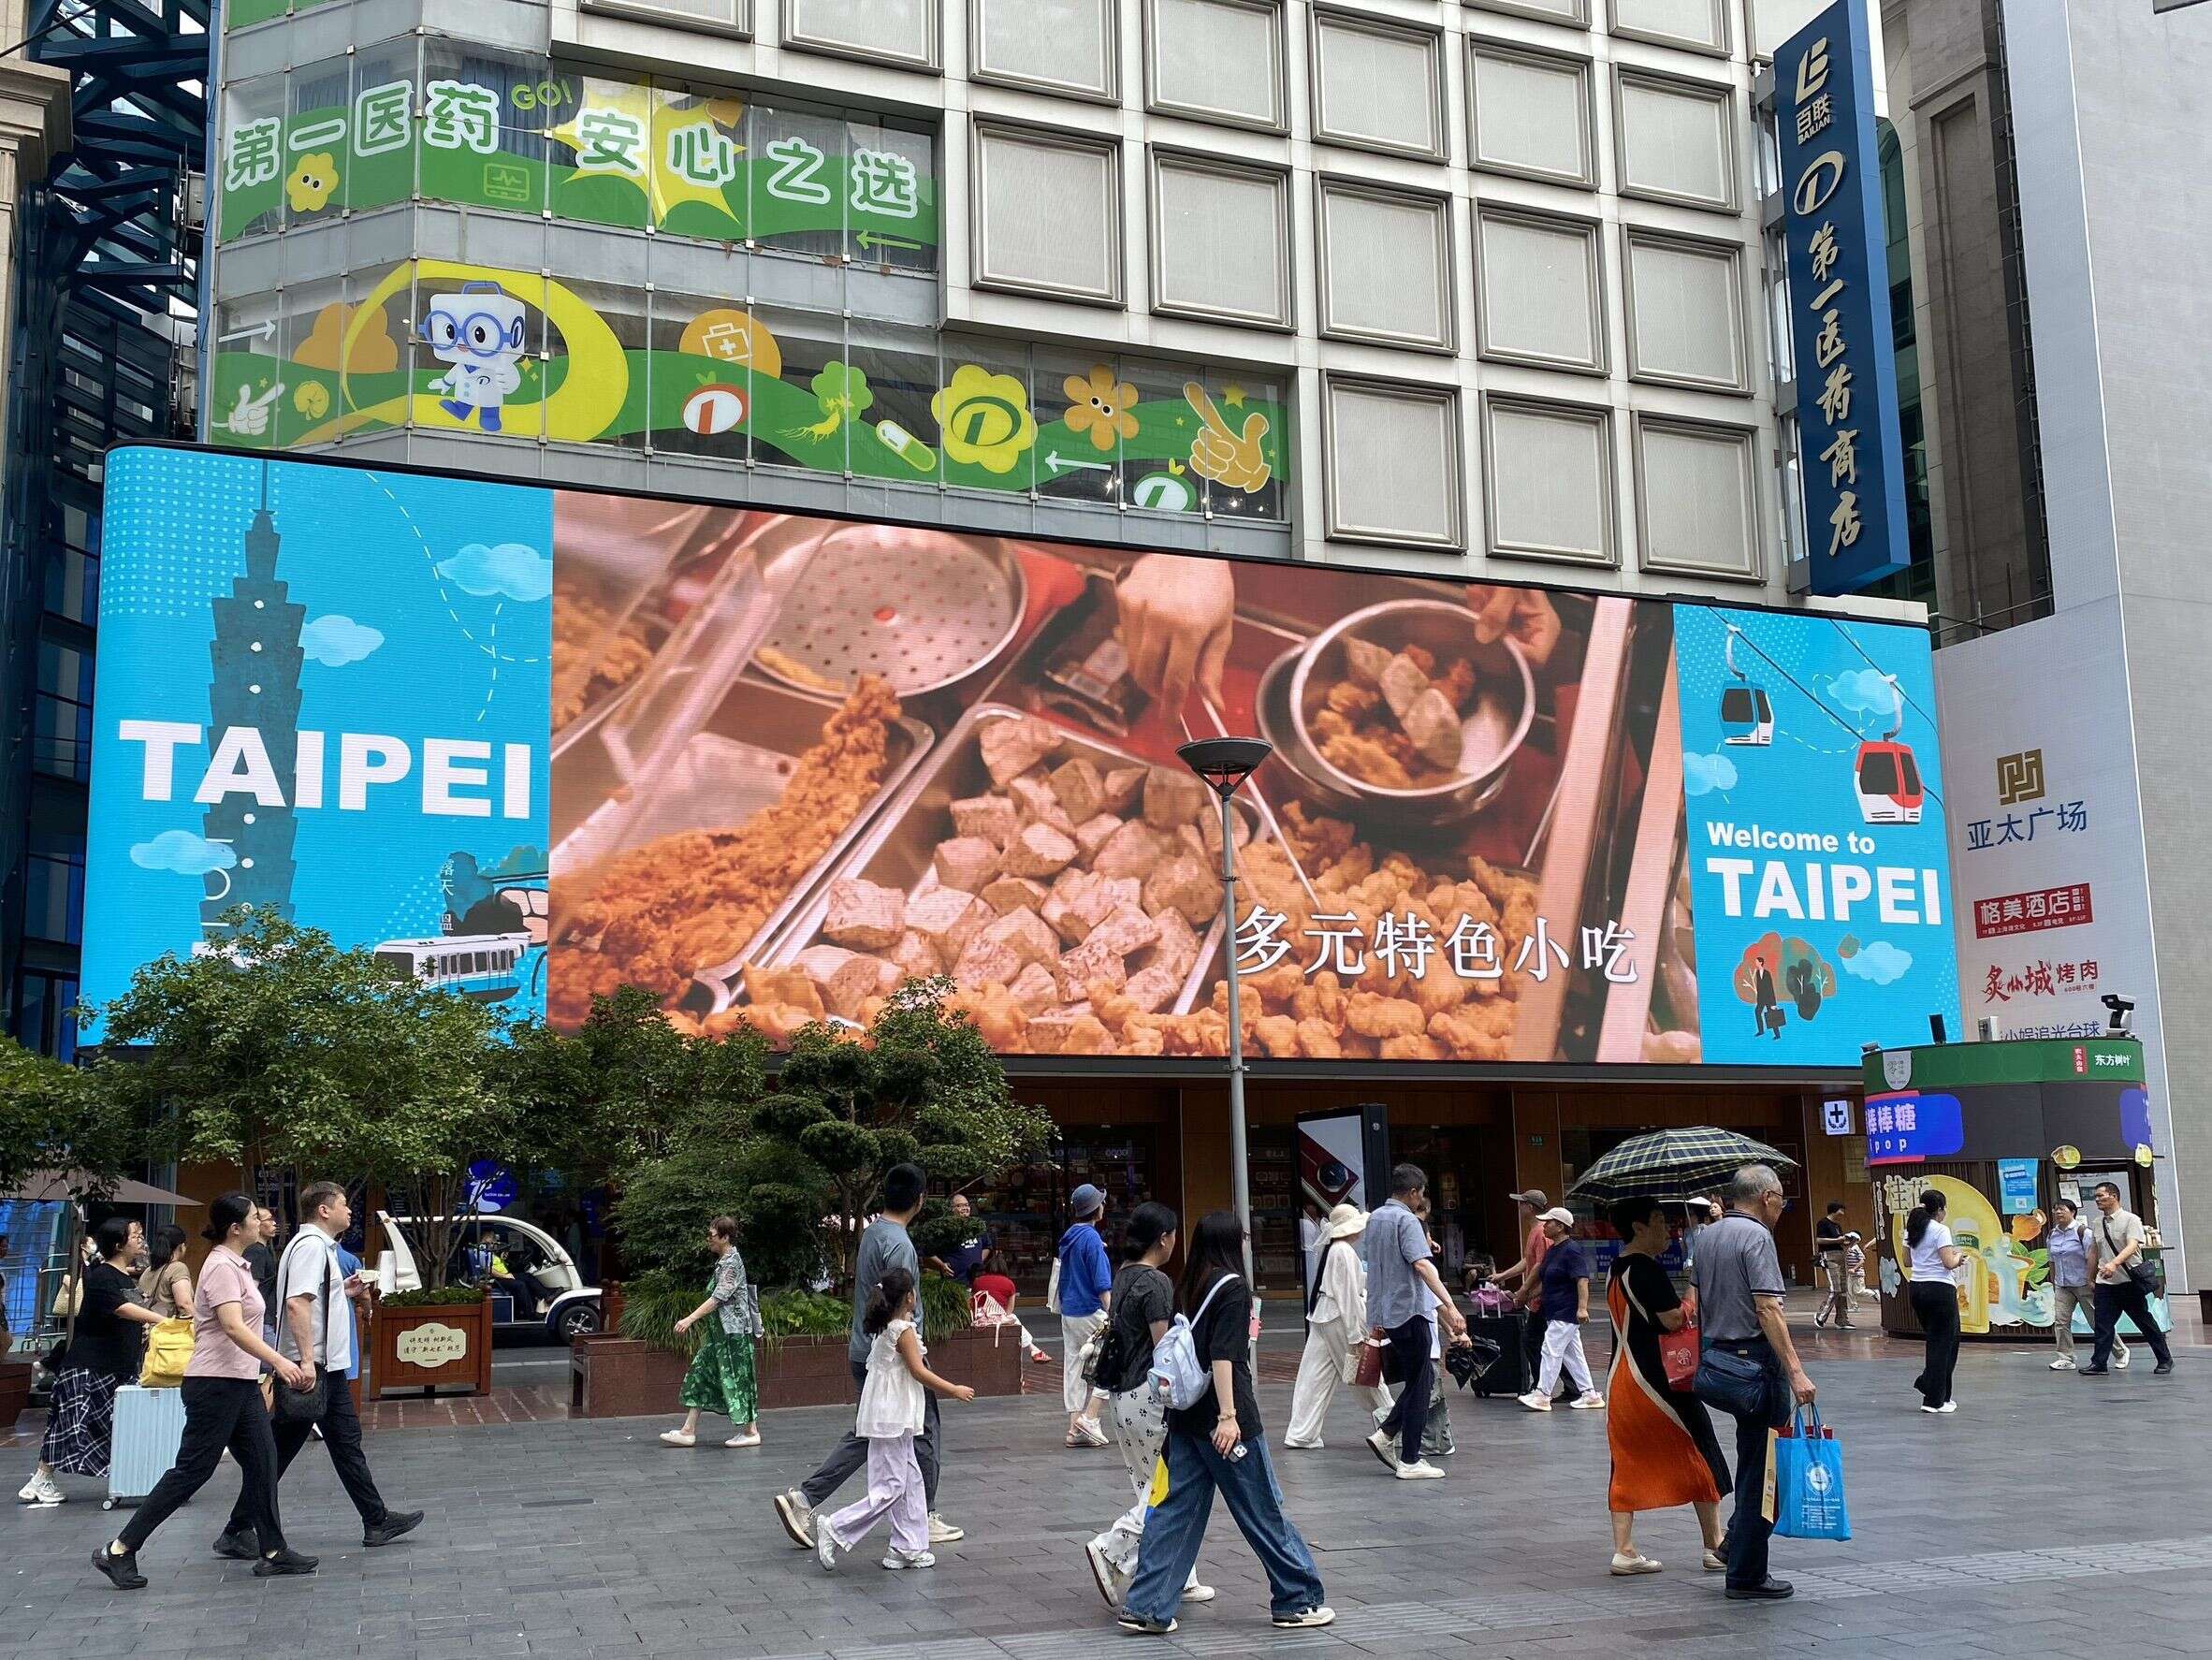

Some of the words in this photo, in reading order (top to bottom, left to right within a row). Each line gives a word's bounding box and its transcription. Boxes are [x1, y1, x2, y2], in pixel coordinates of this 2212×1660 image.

[511, 79, 573, 110] GO!
[1796, 94, 1831, 135] 百联
[225, 80, 499, 192] 第一医药
[1797, 114, 1831, 145] BAILIAN
[575, 106, 919, 219] 安心之选
[1807, 221, 1860, 557] 第一医药商店
[118, 719, 531, 820] TAIPEI
[1706, 821, 1839, 853] Welcome
[1847, 830, 1876, 855] to
[1967, 800, 2087, 851] 亚太广场
[1706, 857, 1943, 925] TAIPEI
[1980, 891, 2070, 925] 格美酒店
[1234, 904, 1639, 983] 多元特色小吃
[2094, 1054, 2132, 1067] 东方树叶
